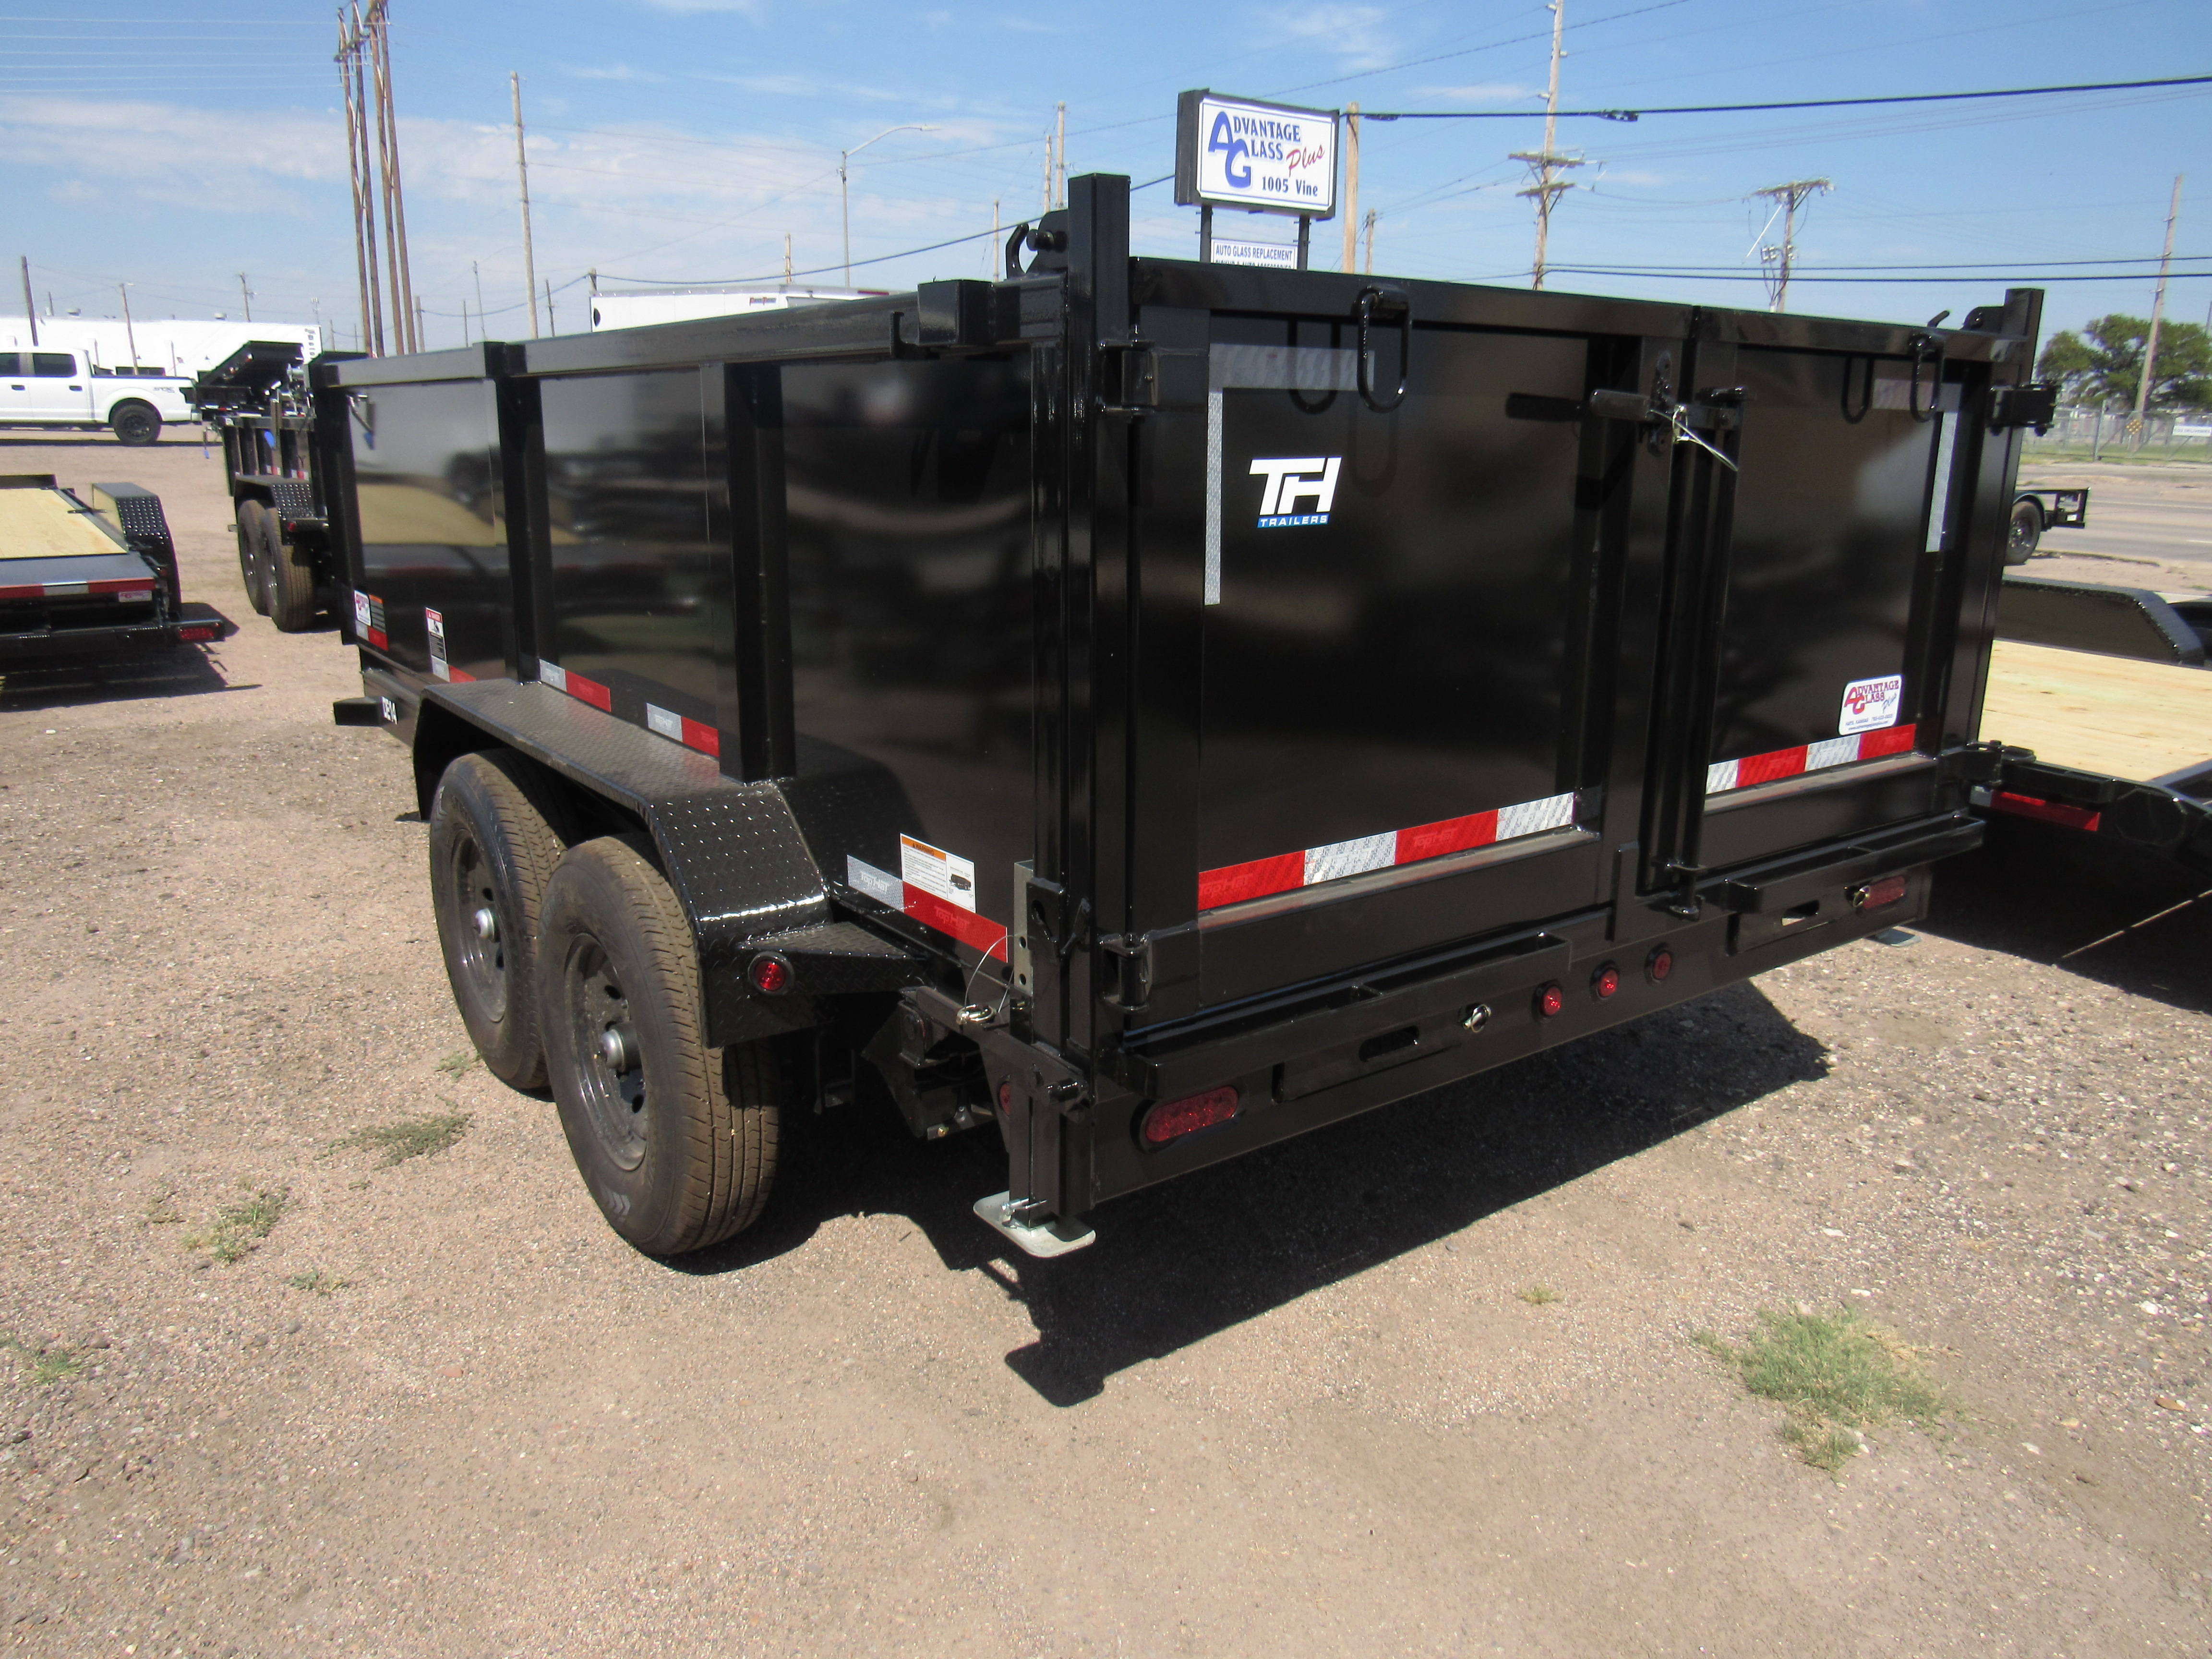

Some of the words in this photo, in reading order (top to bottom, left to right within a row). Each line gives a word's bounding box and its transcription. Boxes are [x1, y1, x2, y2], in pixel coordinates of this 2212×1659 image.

[1286, 144, 1325, 178] Plus
[1262, 176, 1289, 192] 1005
[1296, 179, 1318, 197] Vine
[1215, 244, 1232, 256] AUTO
[1233, 246, 1251, 258] GLASS
[1252, 247, 1293, 261] REPLACEMENT
[1249, 456, 1342, 516] TH
[1260, 515, 1327, 527] TRAILERS
[934, 906, 971, 930] TopHat
